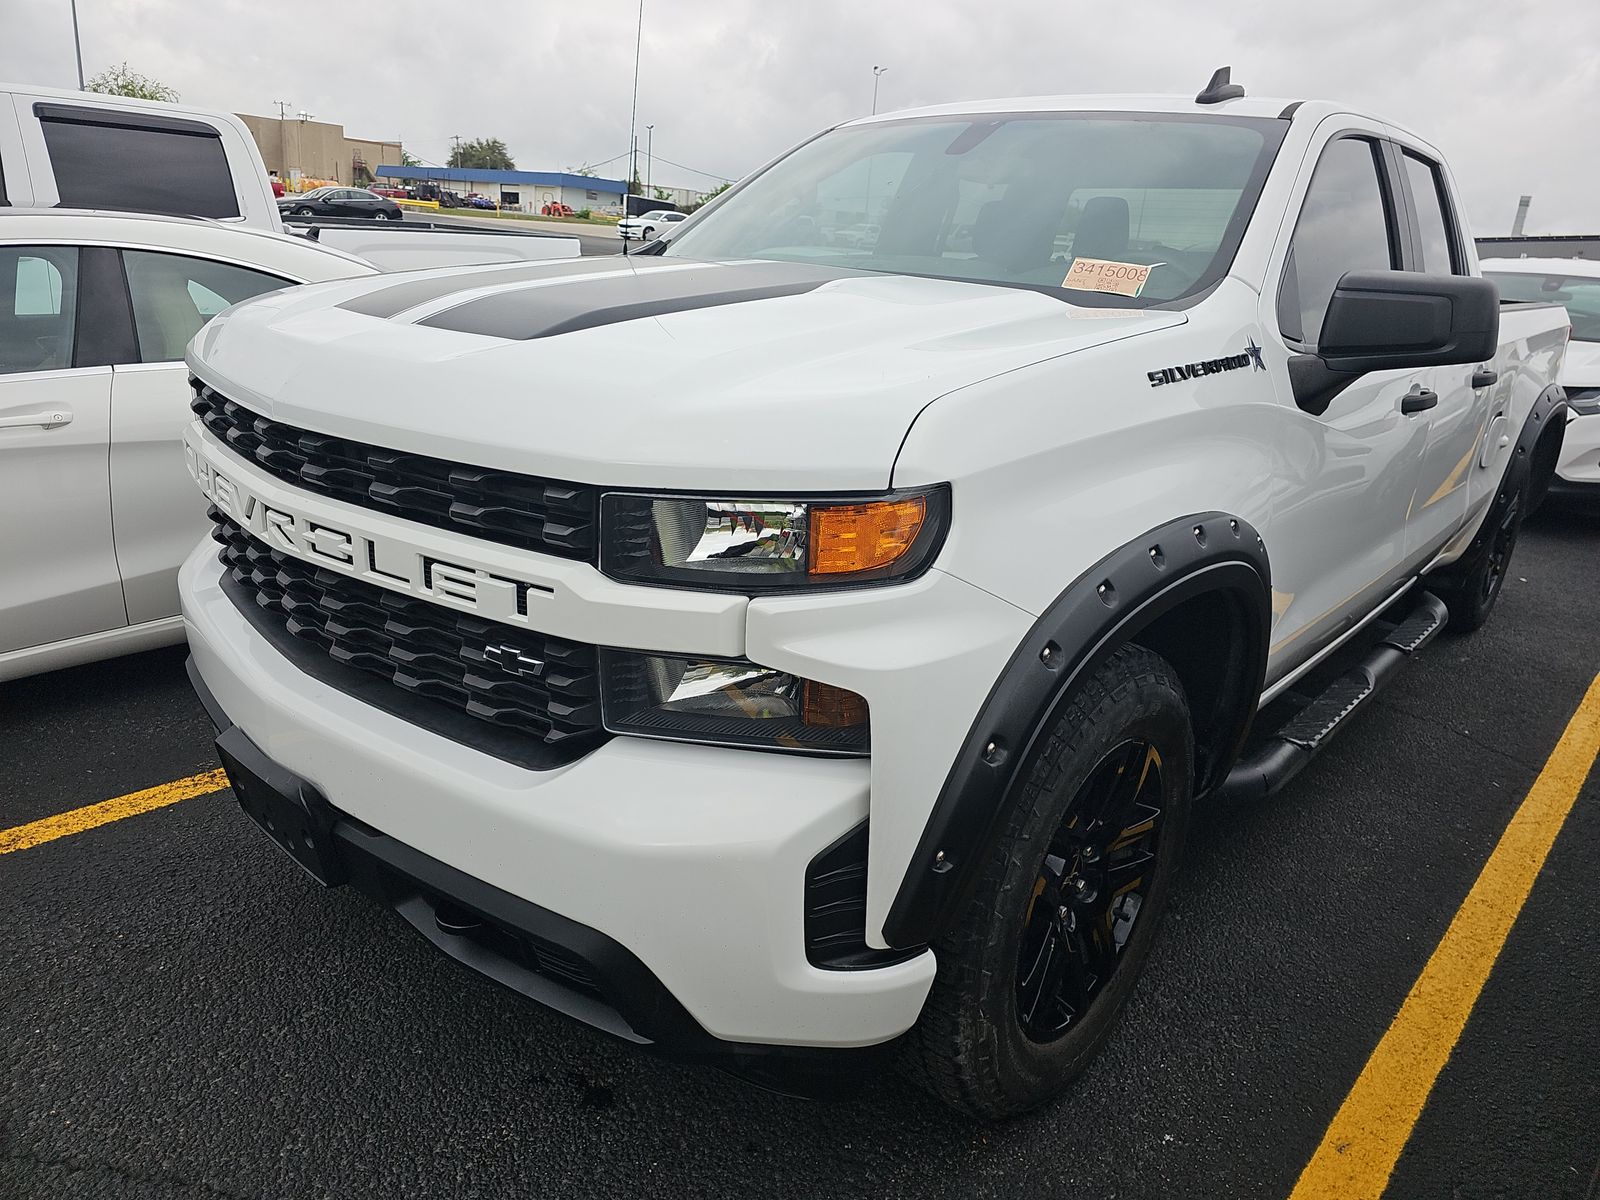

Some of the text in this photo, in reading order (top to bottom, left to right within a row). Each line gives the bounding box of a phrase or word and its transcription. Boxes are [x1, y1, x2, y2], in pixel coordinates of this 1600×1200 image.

[1073, 262, 1149, 283] 3415008
[1147, 353, 1251, 387] SILVERADO
[184, 437, 555, 623] CHEVROLET
